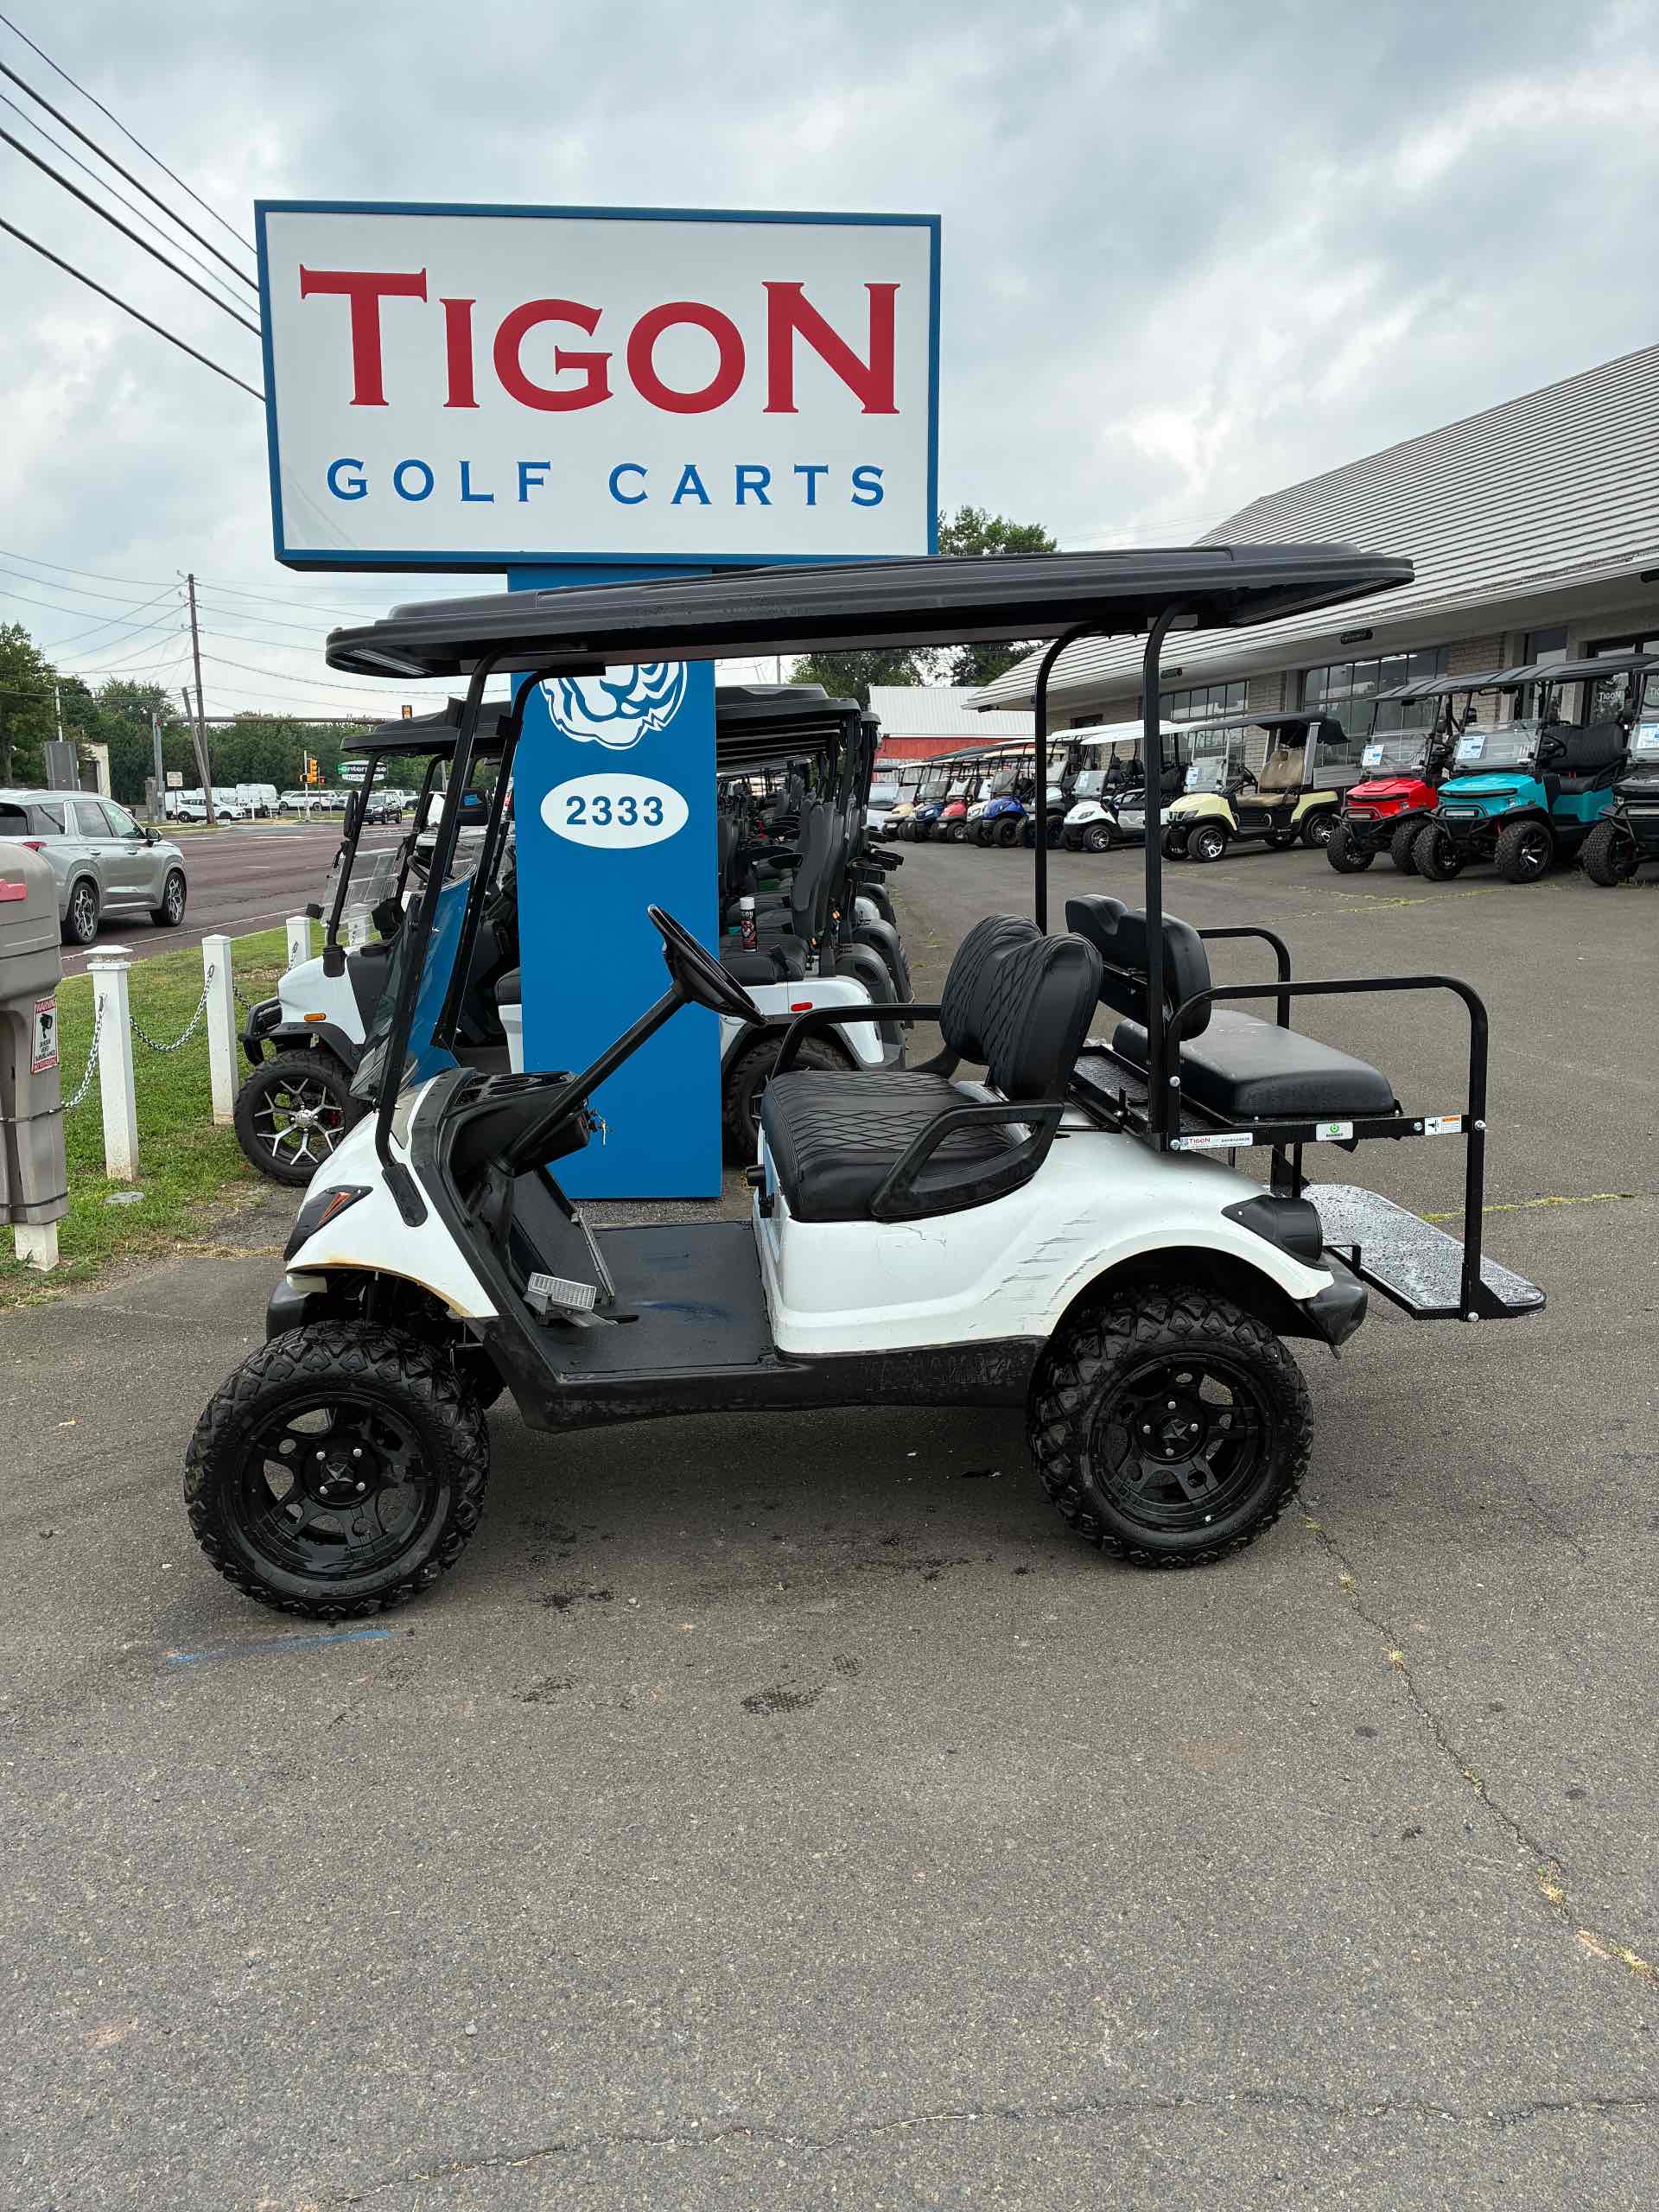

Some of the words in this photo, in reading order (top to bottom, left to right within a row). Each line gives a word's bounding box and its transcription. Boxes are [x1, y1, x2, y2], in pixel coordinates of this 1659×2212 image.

[299, 264, 901, 415] TIGON
[327, 458, 553, 502] GOLF
[607, 462, 886, 506] CARTS
[567, 796, 664, 826] 2333
